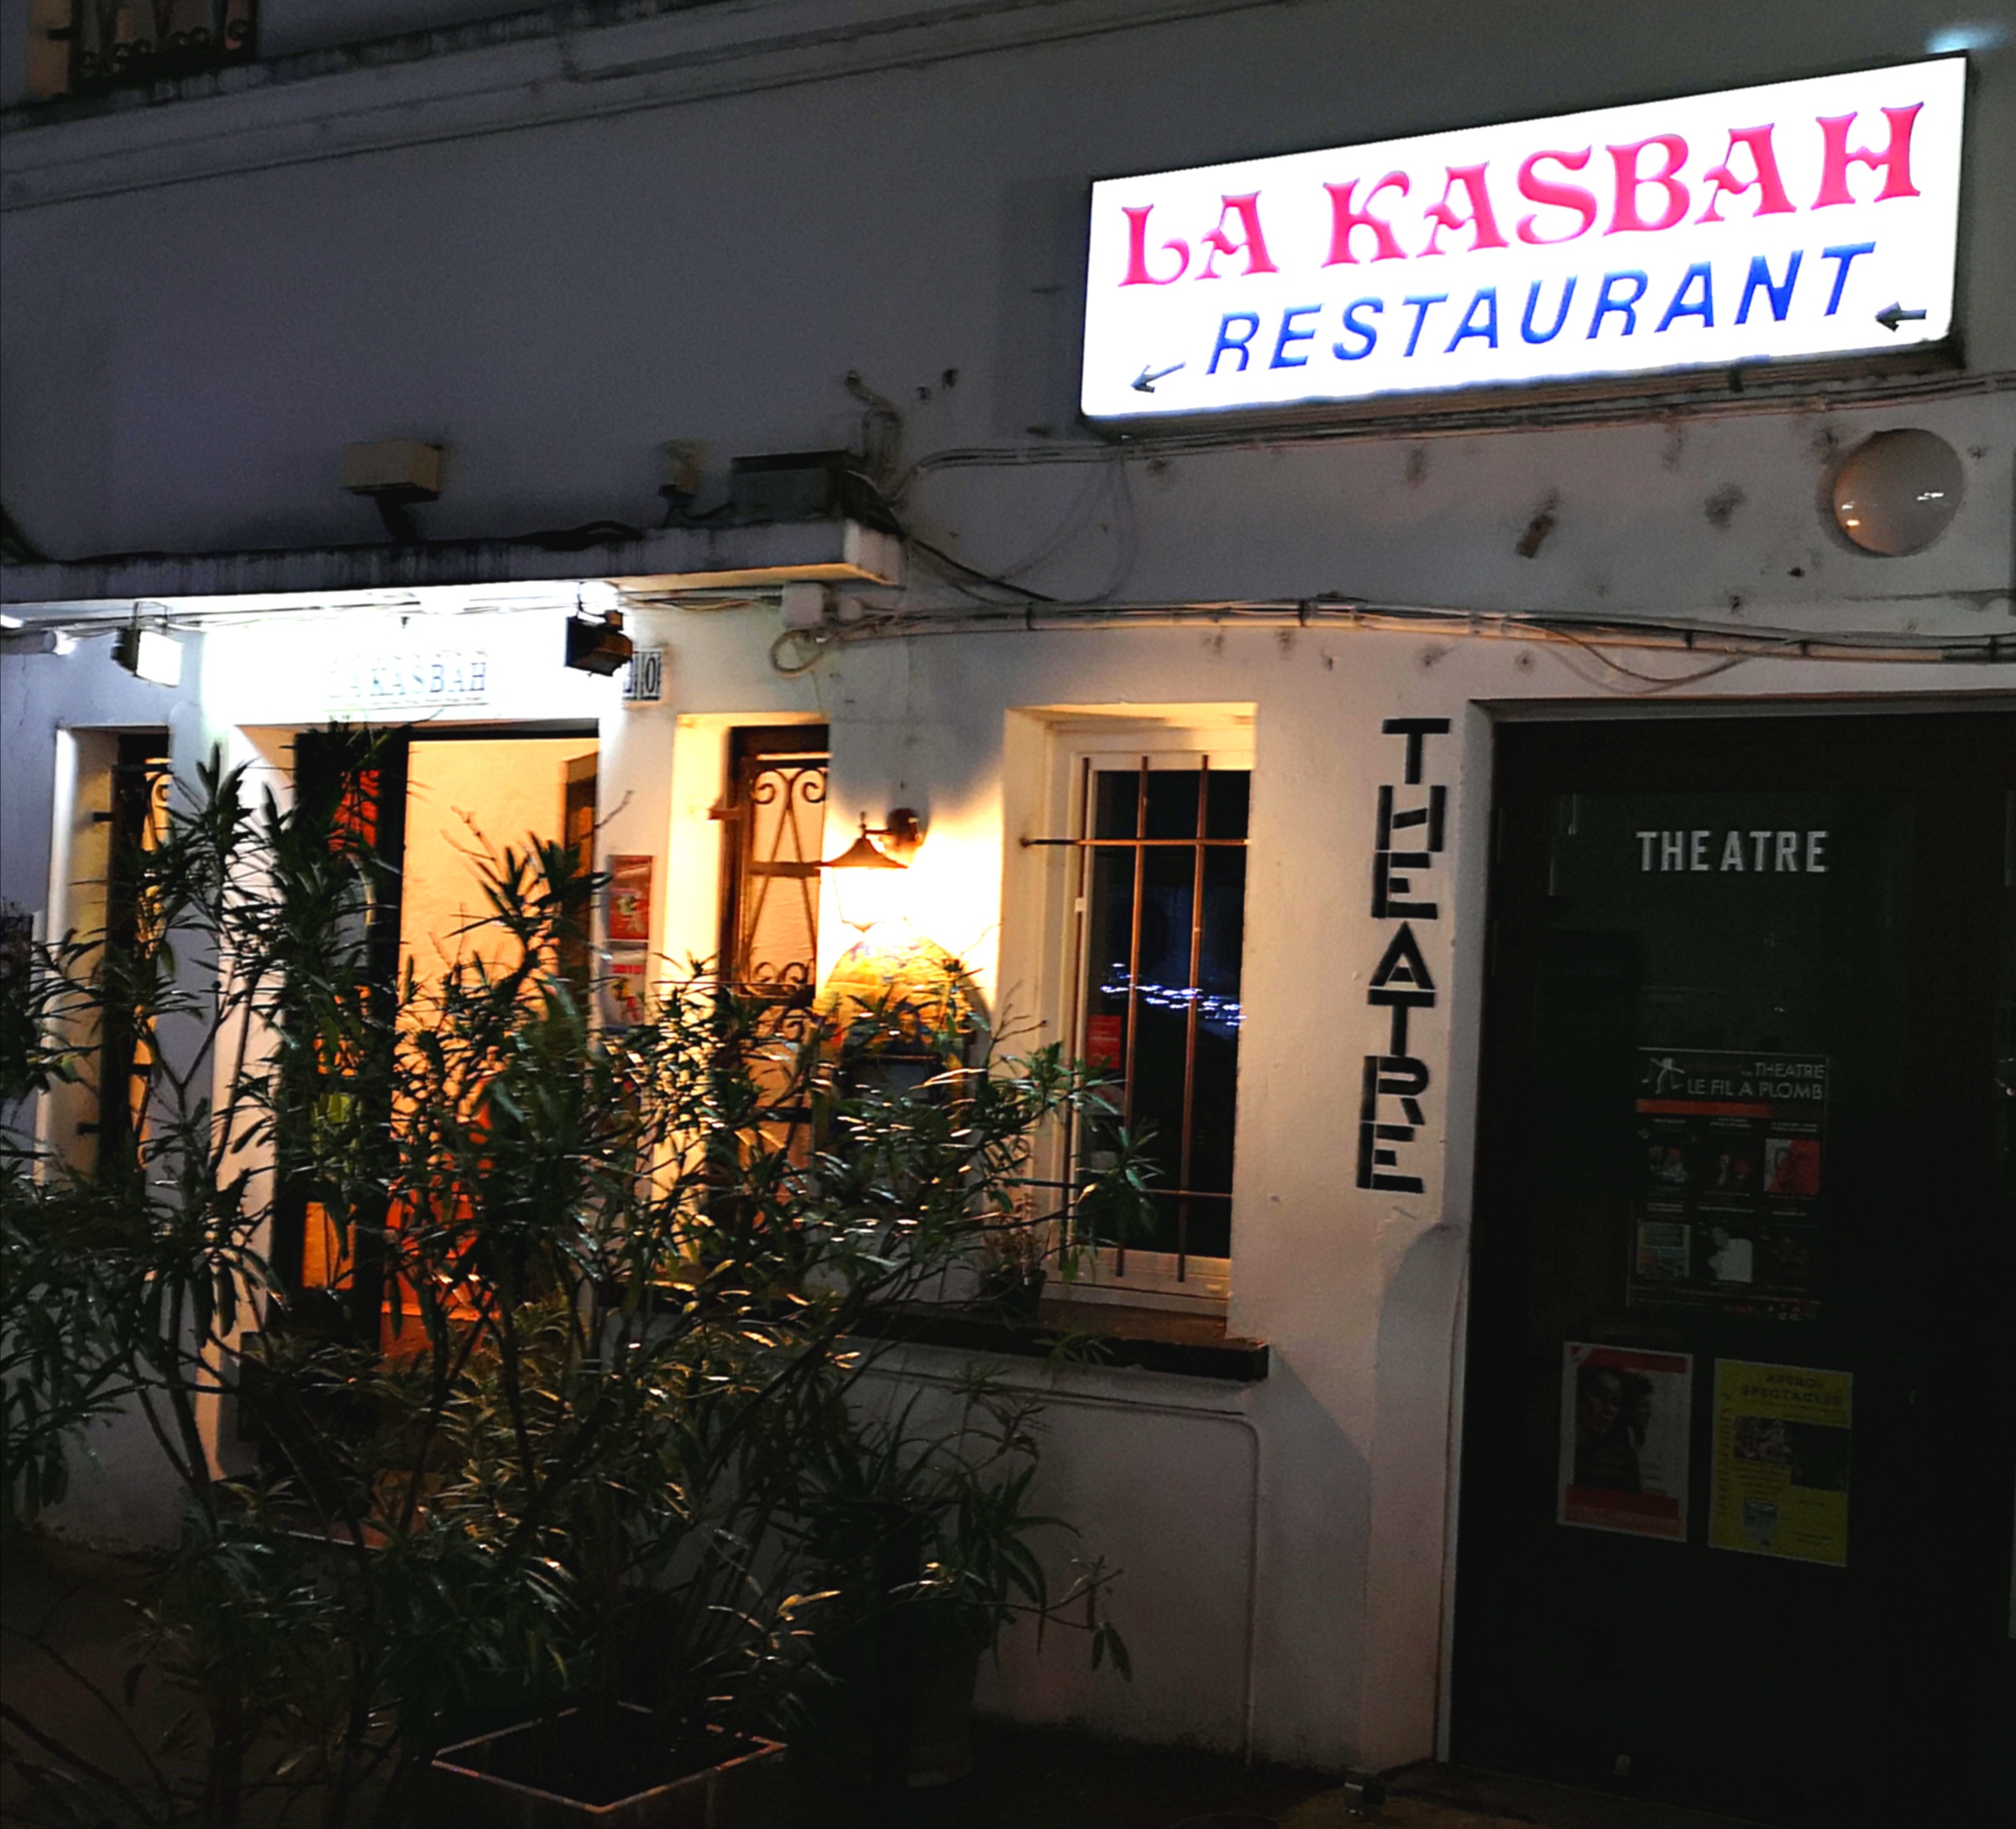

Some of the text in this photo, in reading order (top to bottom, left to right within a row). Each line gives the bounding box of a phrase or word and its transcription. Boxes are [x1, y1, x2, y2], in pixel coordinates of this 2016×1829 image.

[1118, 102, 1924, 287] LA KASBAH
[1206, 242, 1877, 375] RESTAURANT
[369, 662, 487, 698] KASBAH
[1356, 717, 1452, 1194] THEATRE
[1688, 1078, 1705, 1095] LE
[1710, 1079, 1734, 1096] FIL
[1759, 1081, 1822, 1100] PLOMB
[1754, 1062, 1825, 1079] THEATRE
